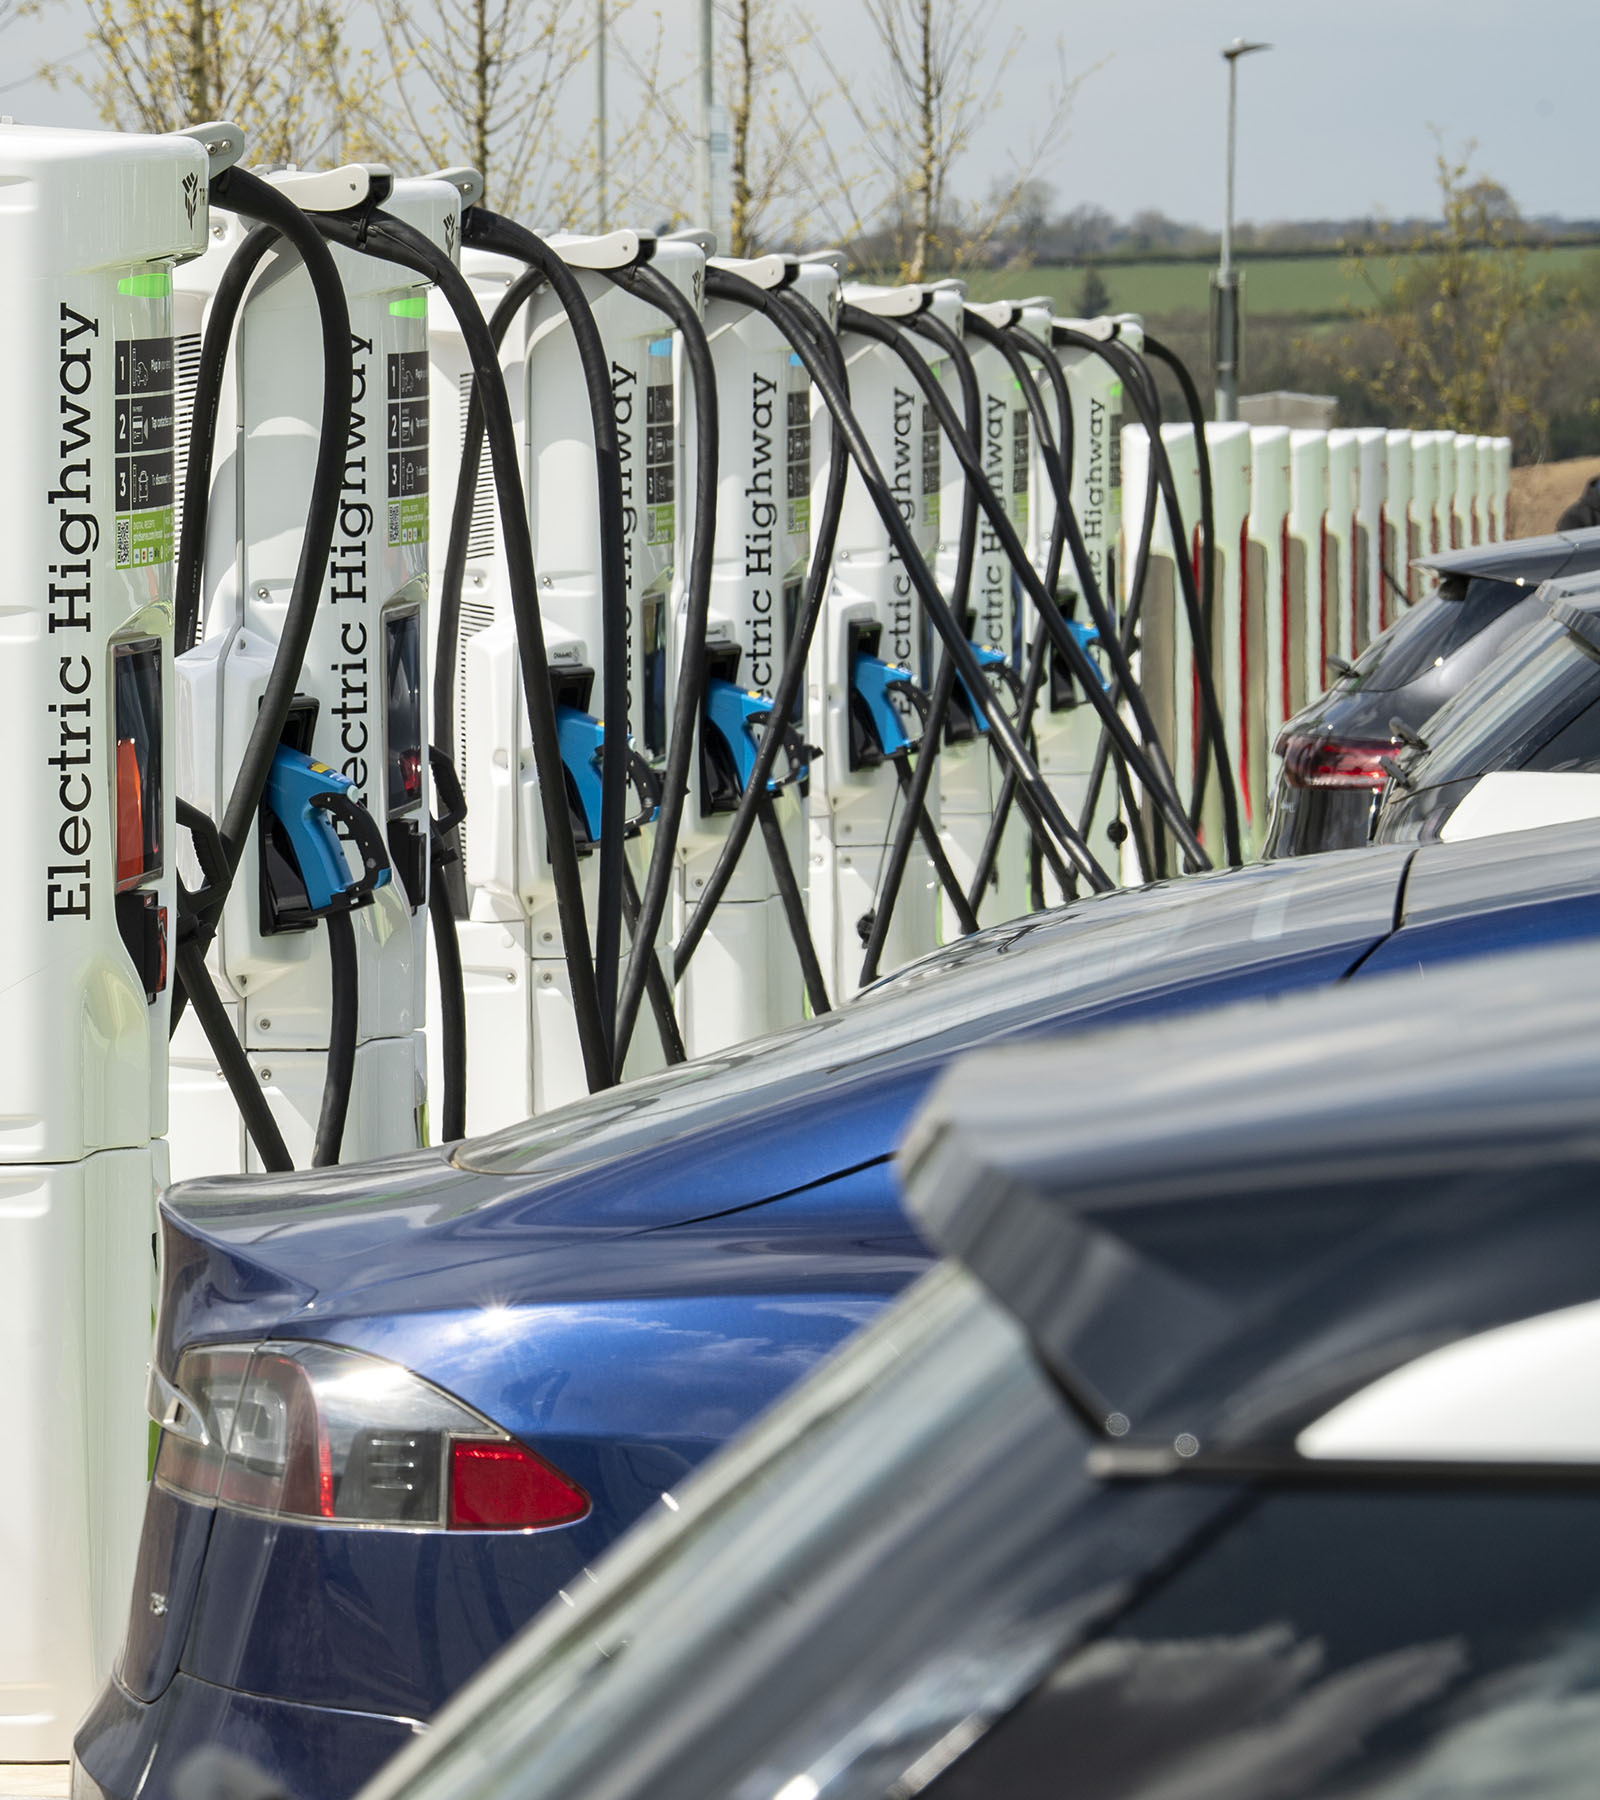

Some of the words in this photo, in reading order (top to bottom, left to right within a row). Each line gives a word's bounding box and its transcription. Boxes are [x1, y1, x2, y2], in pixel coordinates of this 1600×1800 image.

[120, 356, 125, 381] 1
[391, 365, 396, 387] 1
[119, 413, 126, 440] 2
[391, 414, 397, 437] 2
[47, 302, 100, 634] Highway
[120, 472, 126, 497] 3
[391, 463, 398, 485] 3
[744, 372, 778, 577] Highway
[888, 387, 916, 563] ghway
[1084, 397, 1106, 539] Highway
[331, 622, 368, 842] ectric
[47, 655, 92, 922] Electric
